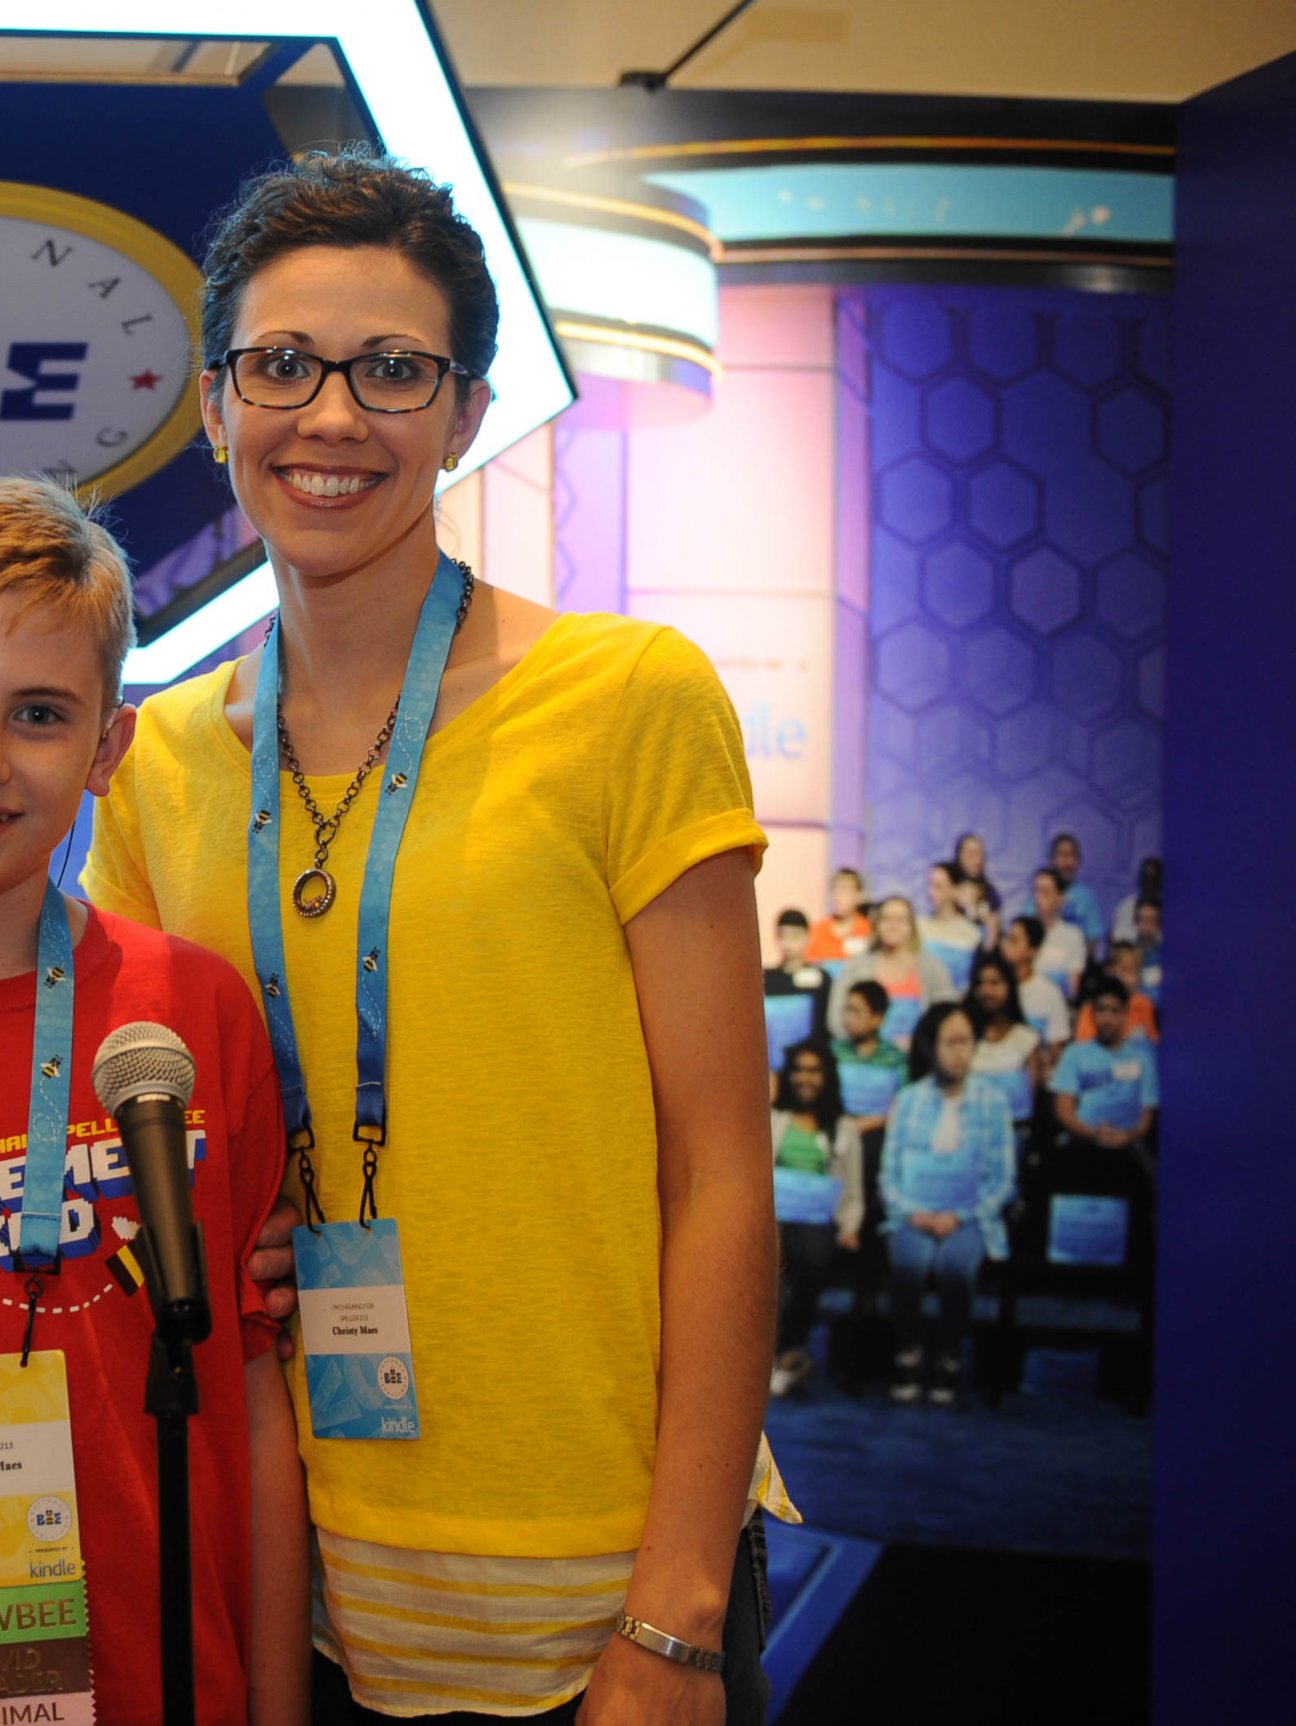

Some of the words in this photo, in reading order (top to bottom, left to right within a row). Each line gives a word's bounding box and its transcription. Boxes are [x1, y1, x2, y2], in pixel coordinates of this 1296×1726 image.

[66, 1117, 119, 1138] PELL
[184, 1109, 206, 1124] EE
[332, 1326, 358, 1337] Christy
[360, 1325, 378, 1334] Maes
[381, 1415, 415, 1433] kindle
[0, 1441, 14, 1451] 213
[29, 1558, 77, 1579] kindle
